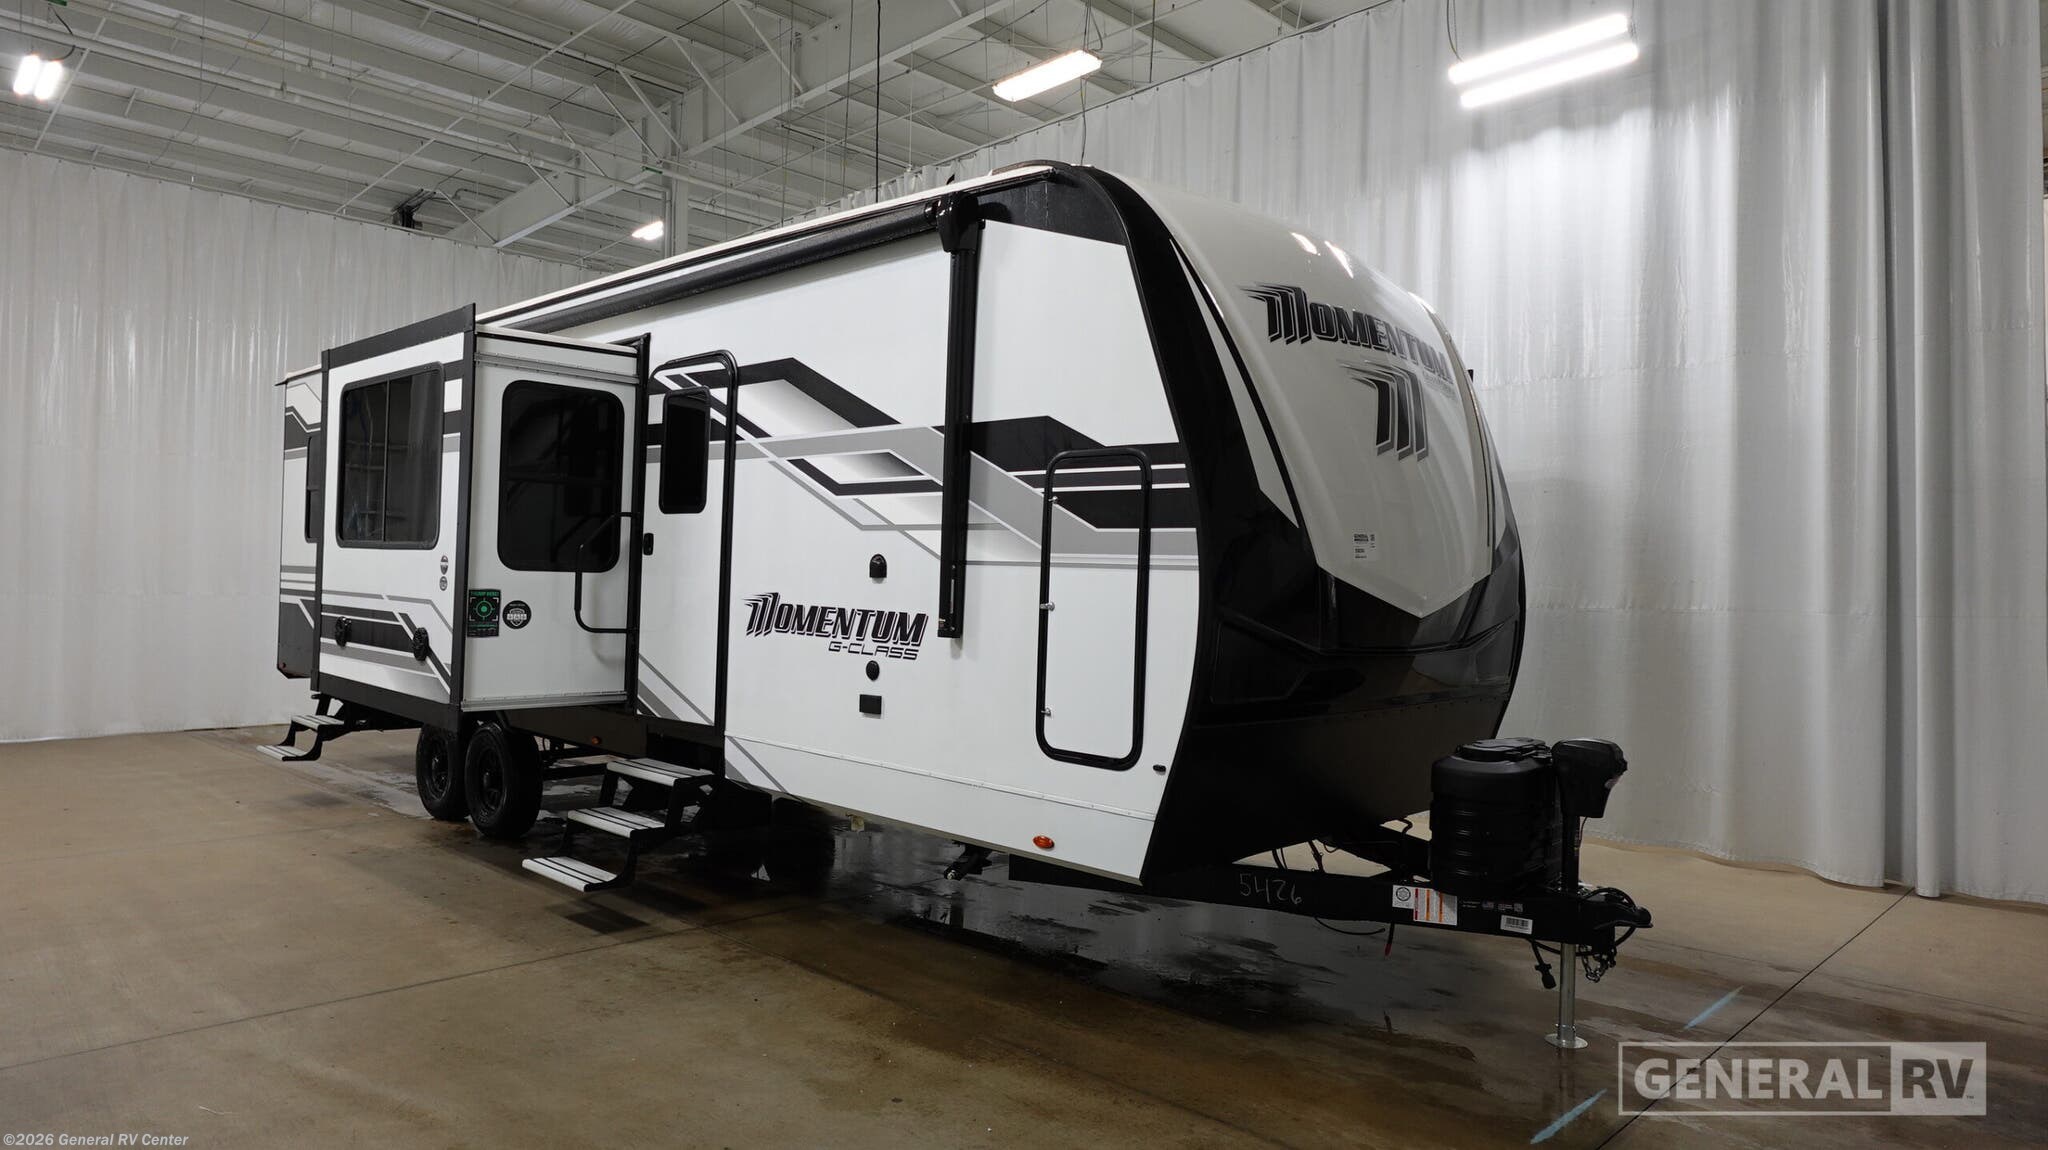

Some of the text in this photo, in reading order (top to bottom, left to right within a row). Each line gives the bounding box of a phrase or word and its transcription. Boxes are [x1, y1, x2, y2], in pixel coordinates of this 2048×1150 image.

[1238, 282, 1453, 383] MOMENTUM
[741, 592, 929, 647] MOMENTUM
[828, 641, 920, 660] G-CLASS
